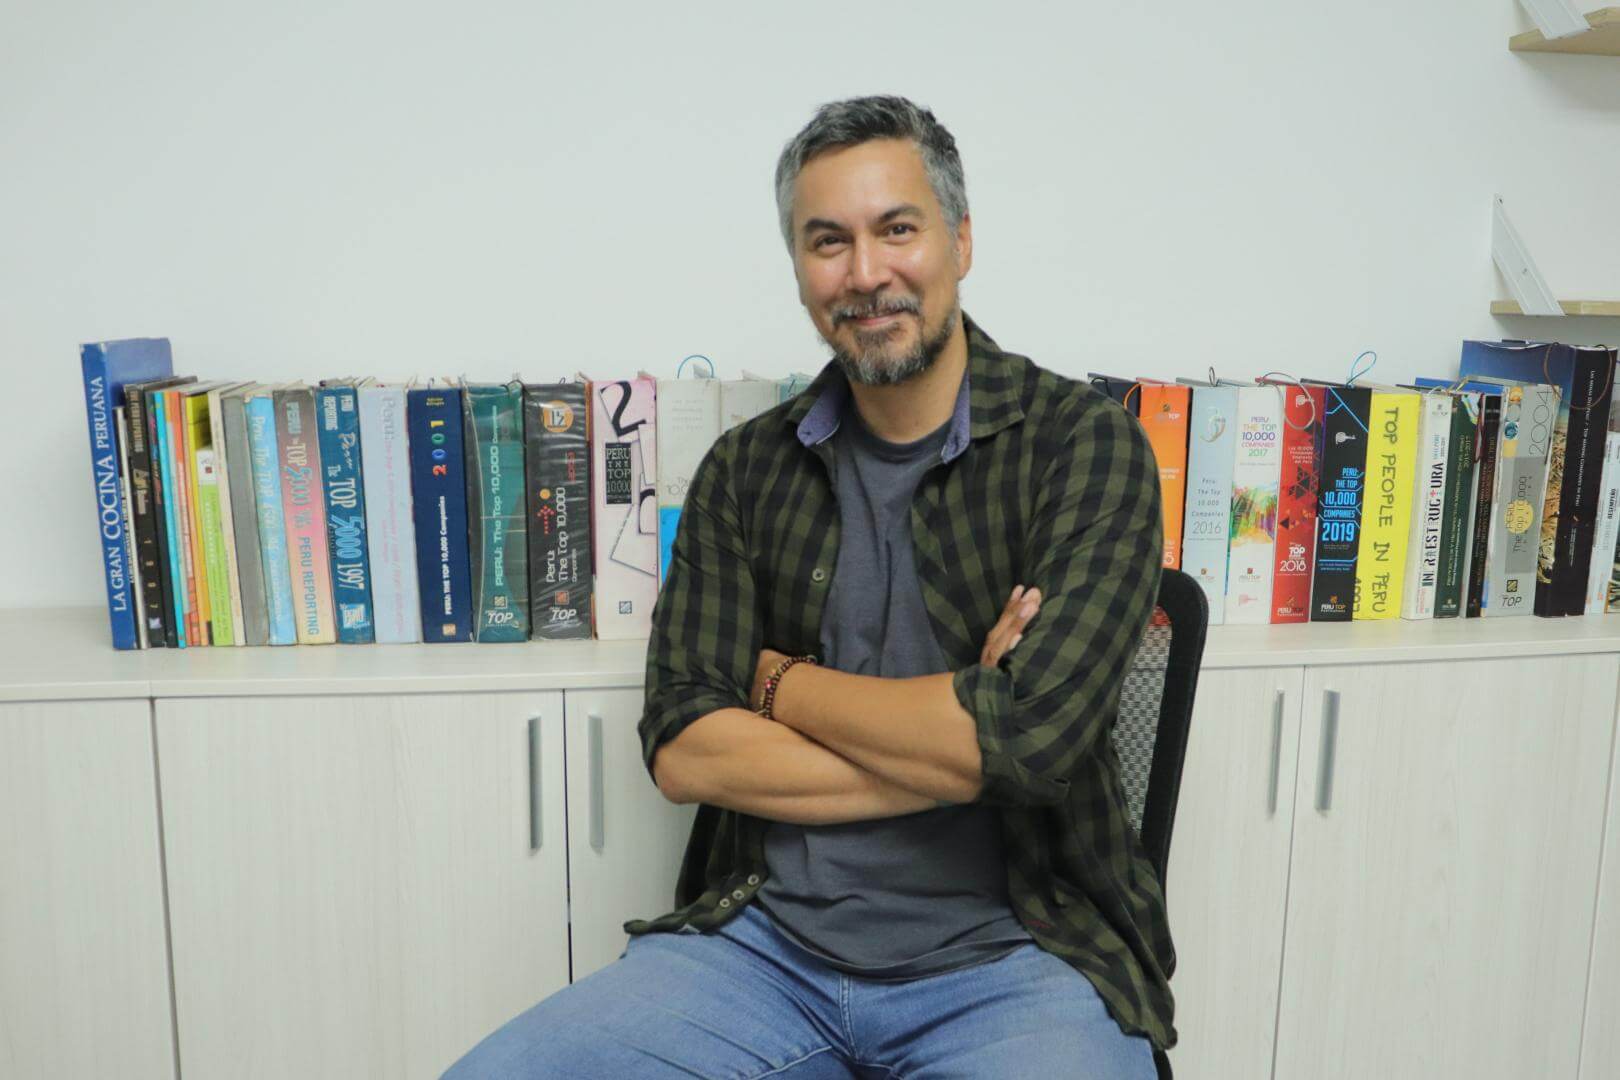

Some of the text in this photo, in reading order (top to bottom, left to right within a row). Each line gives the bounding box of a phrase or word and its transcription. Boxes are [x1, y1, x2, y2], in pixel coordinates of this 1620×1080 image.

[1529, 386, 1552, 455] 2004
[1242, 432, 1276, 441] 10,000
[286, 443, 307, 466] TOP
[430, 420, 447, 476] 2001
[606, 448, 631, 460] PERU
[1248, 448, 1268, 457] 2017
[490, 446, 501, 494] 10,000
[608, 468, 631, 479] TOP
[93, 376, 126, 612] LA GRAN COCINA PERUANA
[329, 478, 357, 508] TOP
[1336, 480, 1358, 488] THE TOP
[492, 496, 503, 518] Top
[1324, 492, 1356, 506] 10,000
[1371, 406, 1399, 614] TOP PEOPLE IN PERU
[438, 496, 448, 536] Companies
[1324, 510, 1356, 518] COMPANIES
[493, 520, 502, 542] The
[556, 487, 569, 582] The Top 10,000
[1192, 520, 1222, 534] 2016
[1322, 522, 1354, 542] 2019
[298, 536, 312, 567] PERU
[440, 536, 449, 562] 10,000
[337, 562, 364, 591] 1997
[302, 571, 320, 636] REPORTING
[1502, 596, 1522, 607] TOP
[488, 612, 514, 624] TOP
[552, 608, 576, 621] TOP
